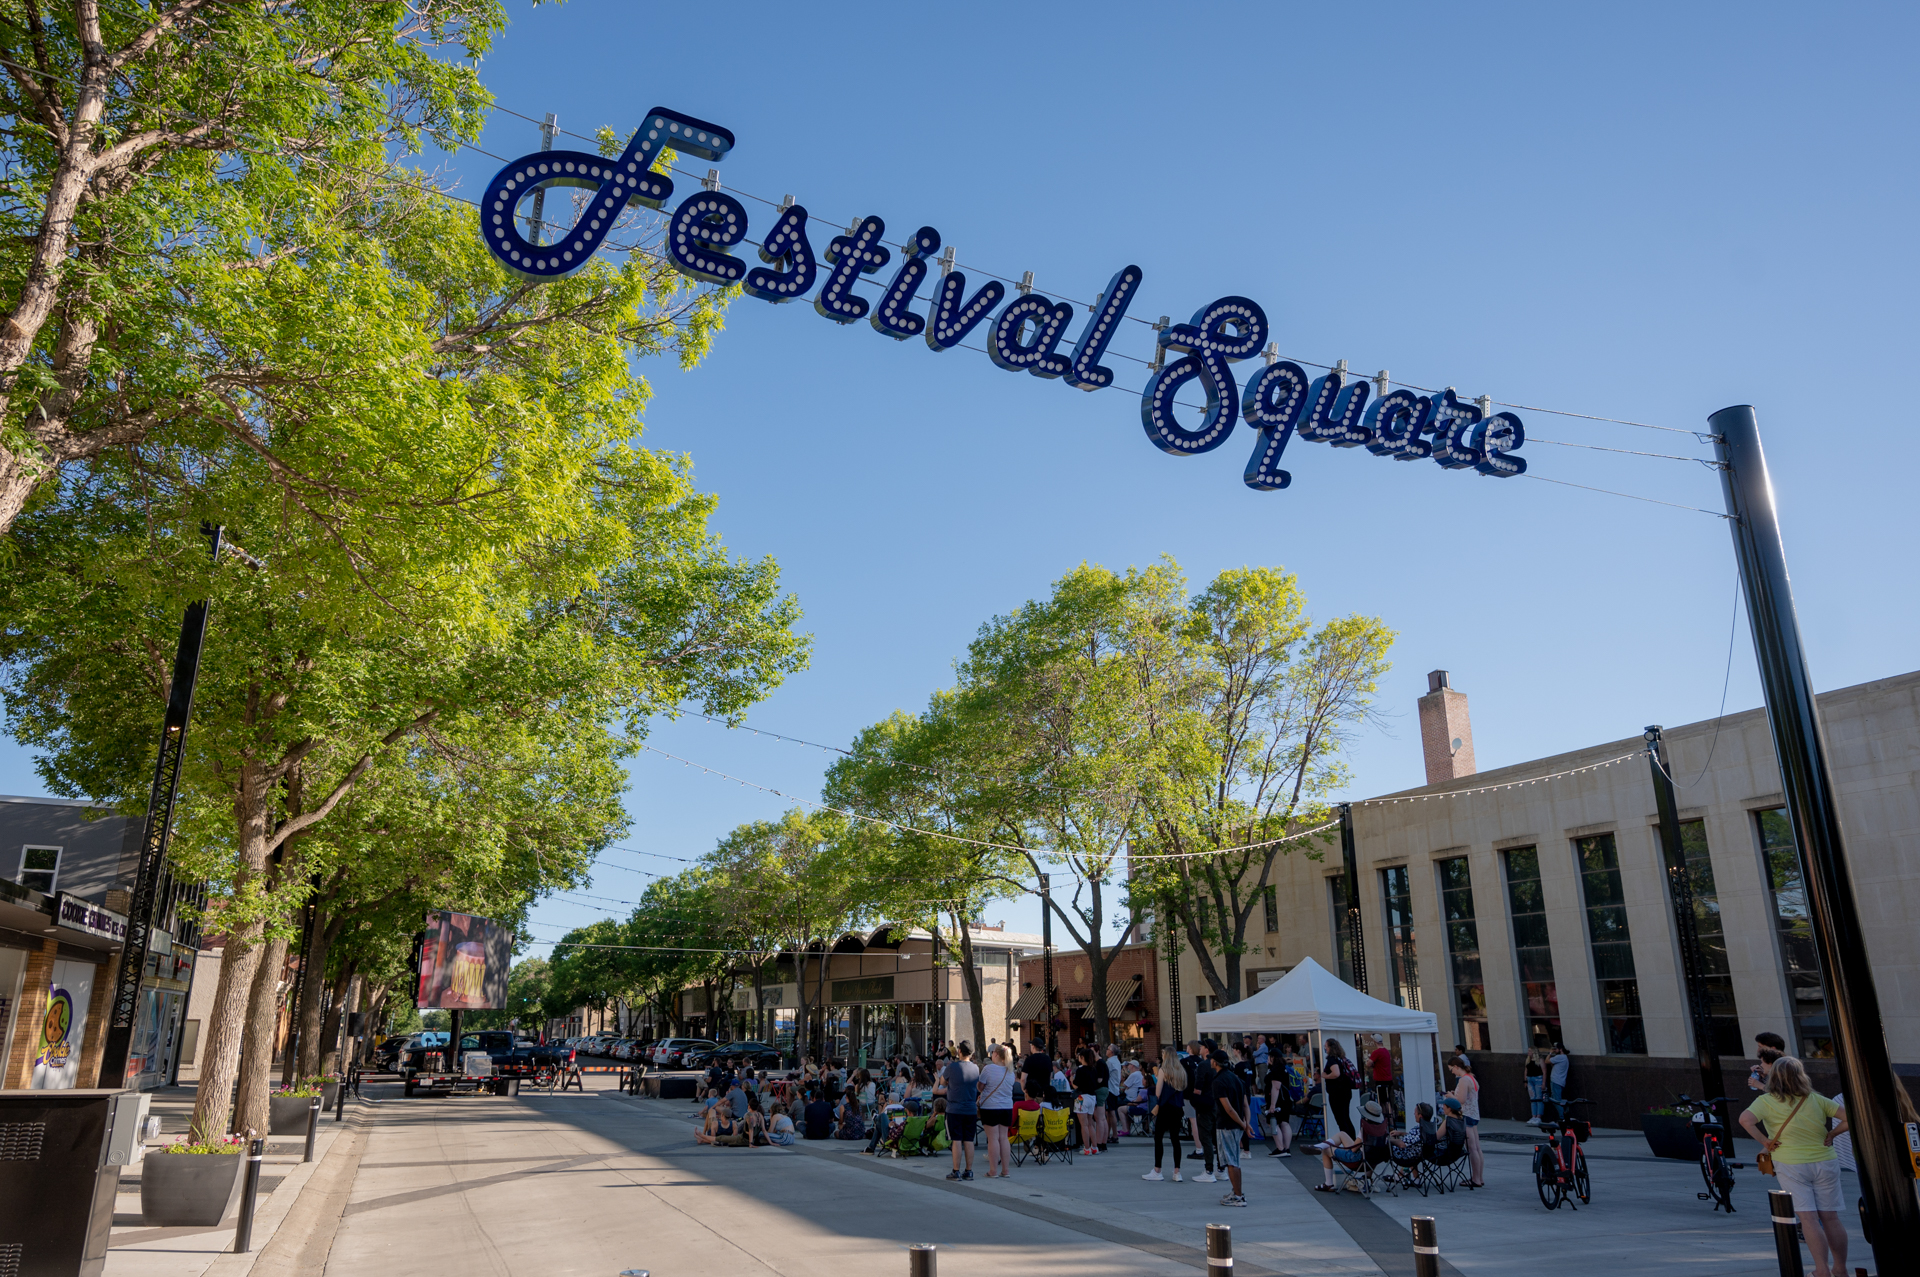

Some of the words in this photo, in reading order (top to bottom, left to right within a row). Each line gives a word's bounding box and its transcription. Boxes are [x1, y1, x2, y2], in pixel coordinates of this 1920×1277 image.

[480, 106, 1143, 393] Festival
[1140, 295, 1528, 491] Square
[61, 900, 88, 926] COOKIE
